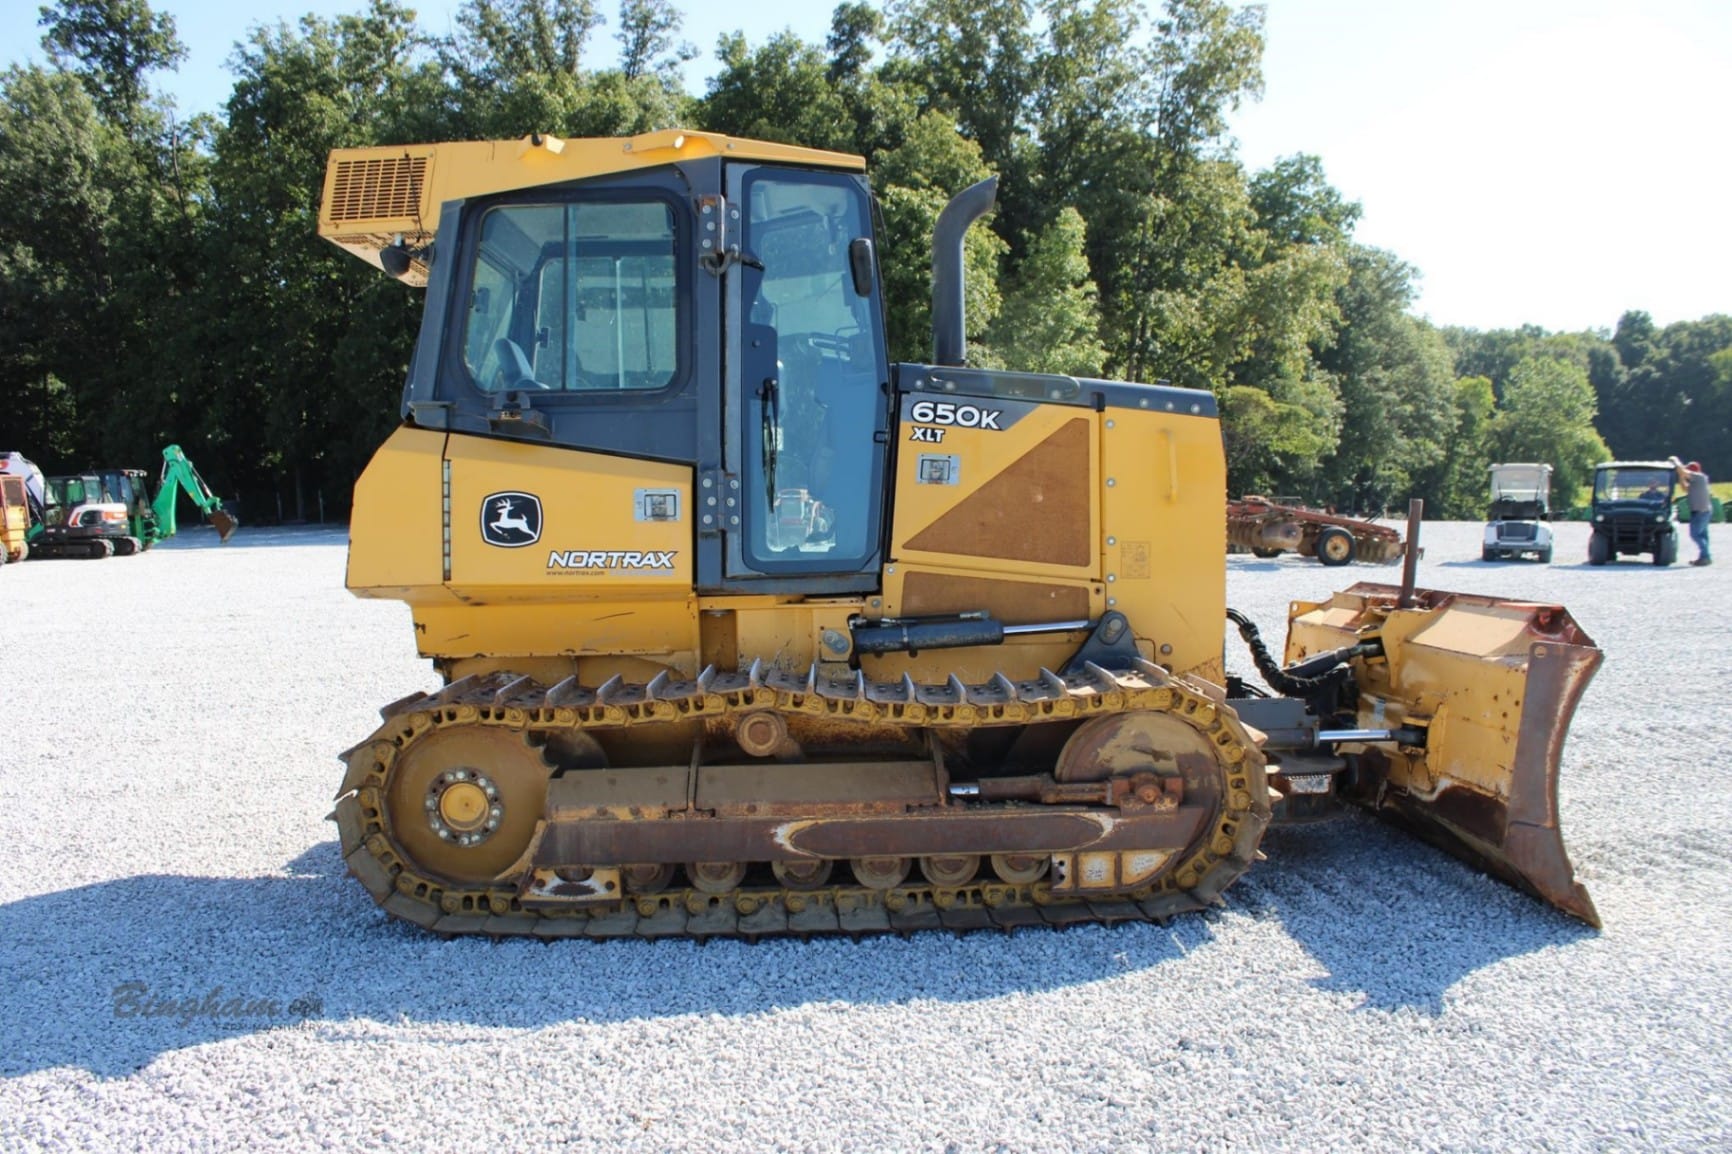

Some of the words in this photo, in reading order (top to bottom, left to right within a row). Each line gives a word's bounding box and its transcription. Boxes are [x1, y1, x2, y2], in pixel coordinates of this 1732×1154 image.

[911, 401, 1003, 431] 650K
[909, 426, 945, 443] XLT
[547, 550, 678, 569] NORTRAX
